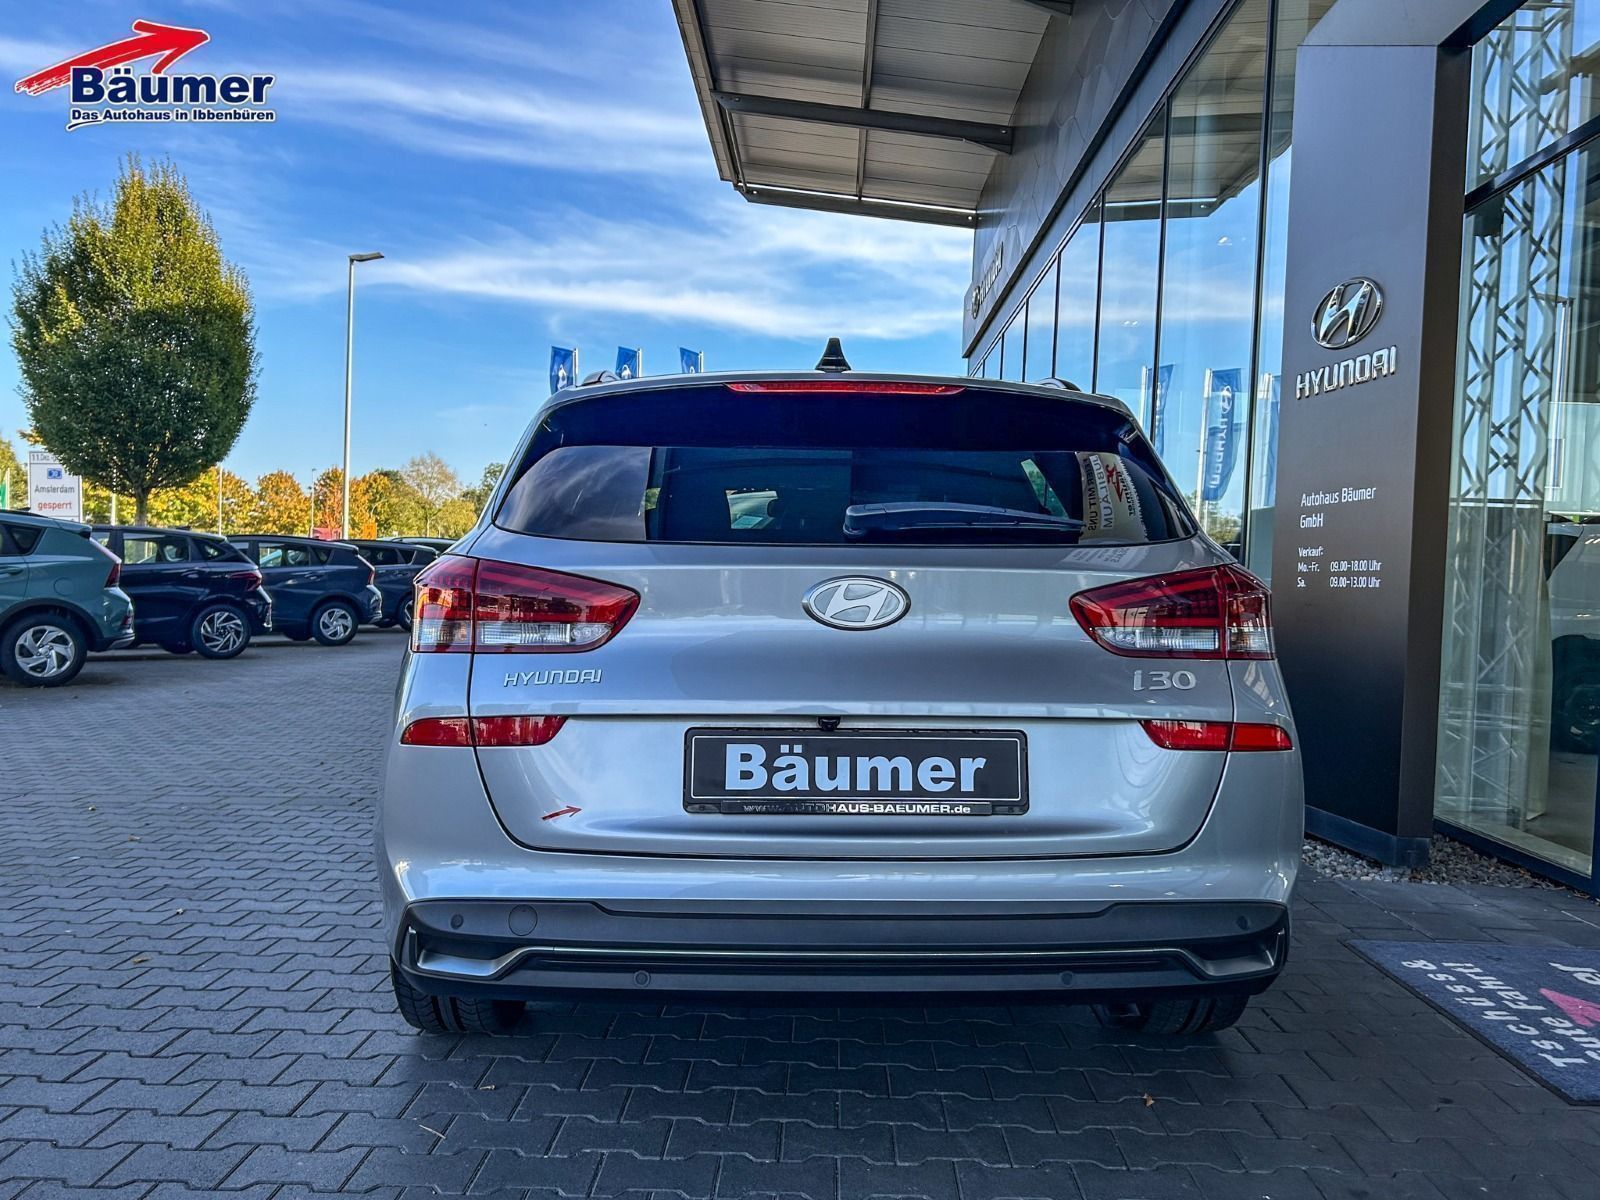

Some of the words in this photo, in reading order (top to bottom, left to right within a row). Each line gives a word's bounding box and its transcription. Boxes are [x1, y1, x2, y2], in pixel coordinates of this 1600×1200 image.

[1296, 346, 1397, 400] HYUNDAI
[34, 484, 75, 493] Amsterdam
[1301, 491, 1340, 507] Autohaus
[1341, 487, 1377, 503] Bäumer
[37, 501, 72, 511] gesperrt
[1300, 513, 1324, 529] GmbH
[1298, 546, 1324, 557] Verkauf:
[1297, 562, 1320, 572] Mo.-Fr.
[1369, 560, 1382, 571] Uhr
[1297, 577, 1306, 588] Sa.
[1368, 577, 1381, 588] Uhr
[503, 669, 603, 687] HYUNDAI
[1133, 670, 1197, 691] i30
[724, 743, 987, 792] Bäumer
[1441, 962, 1547, 1010] Fahrt!
[1427, 973, 1588, 1067] Tschüss
